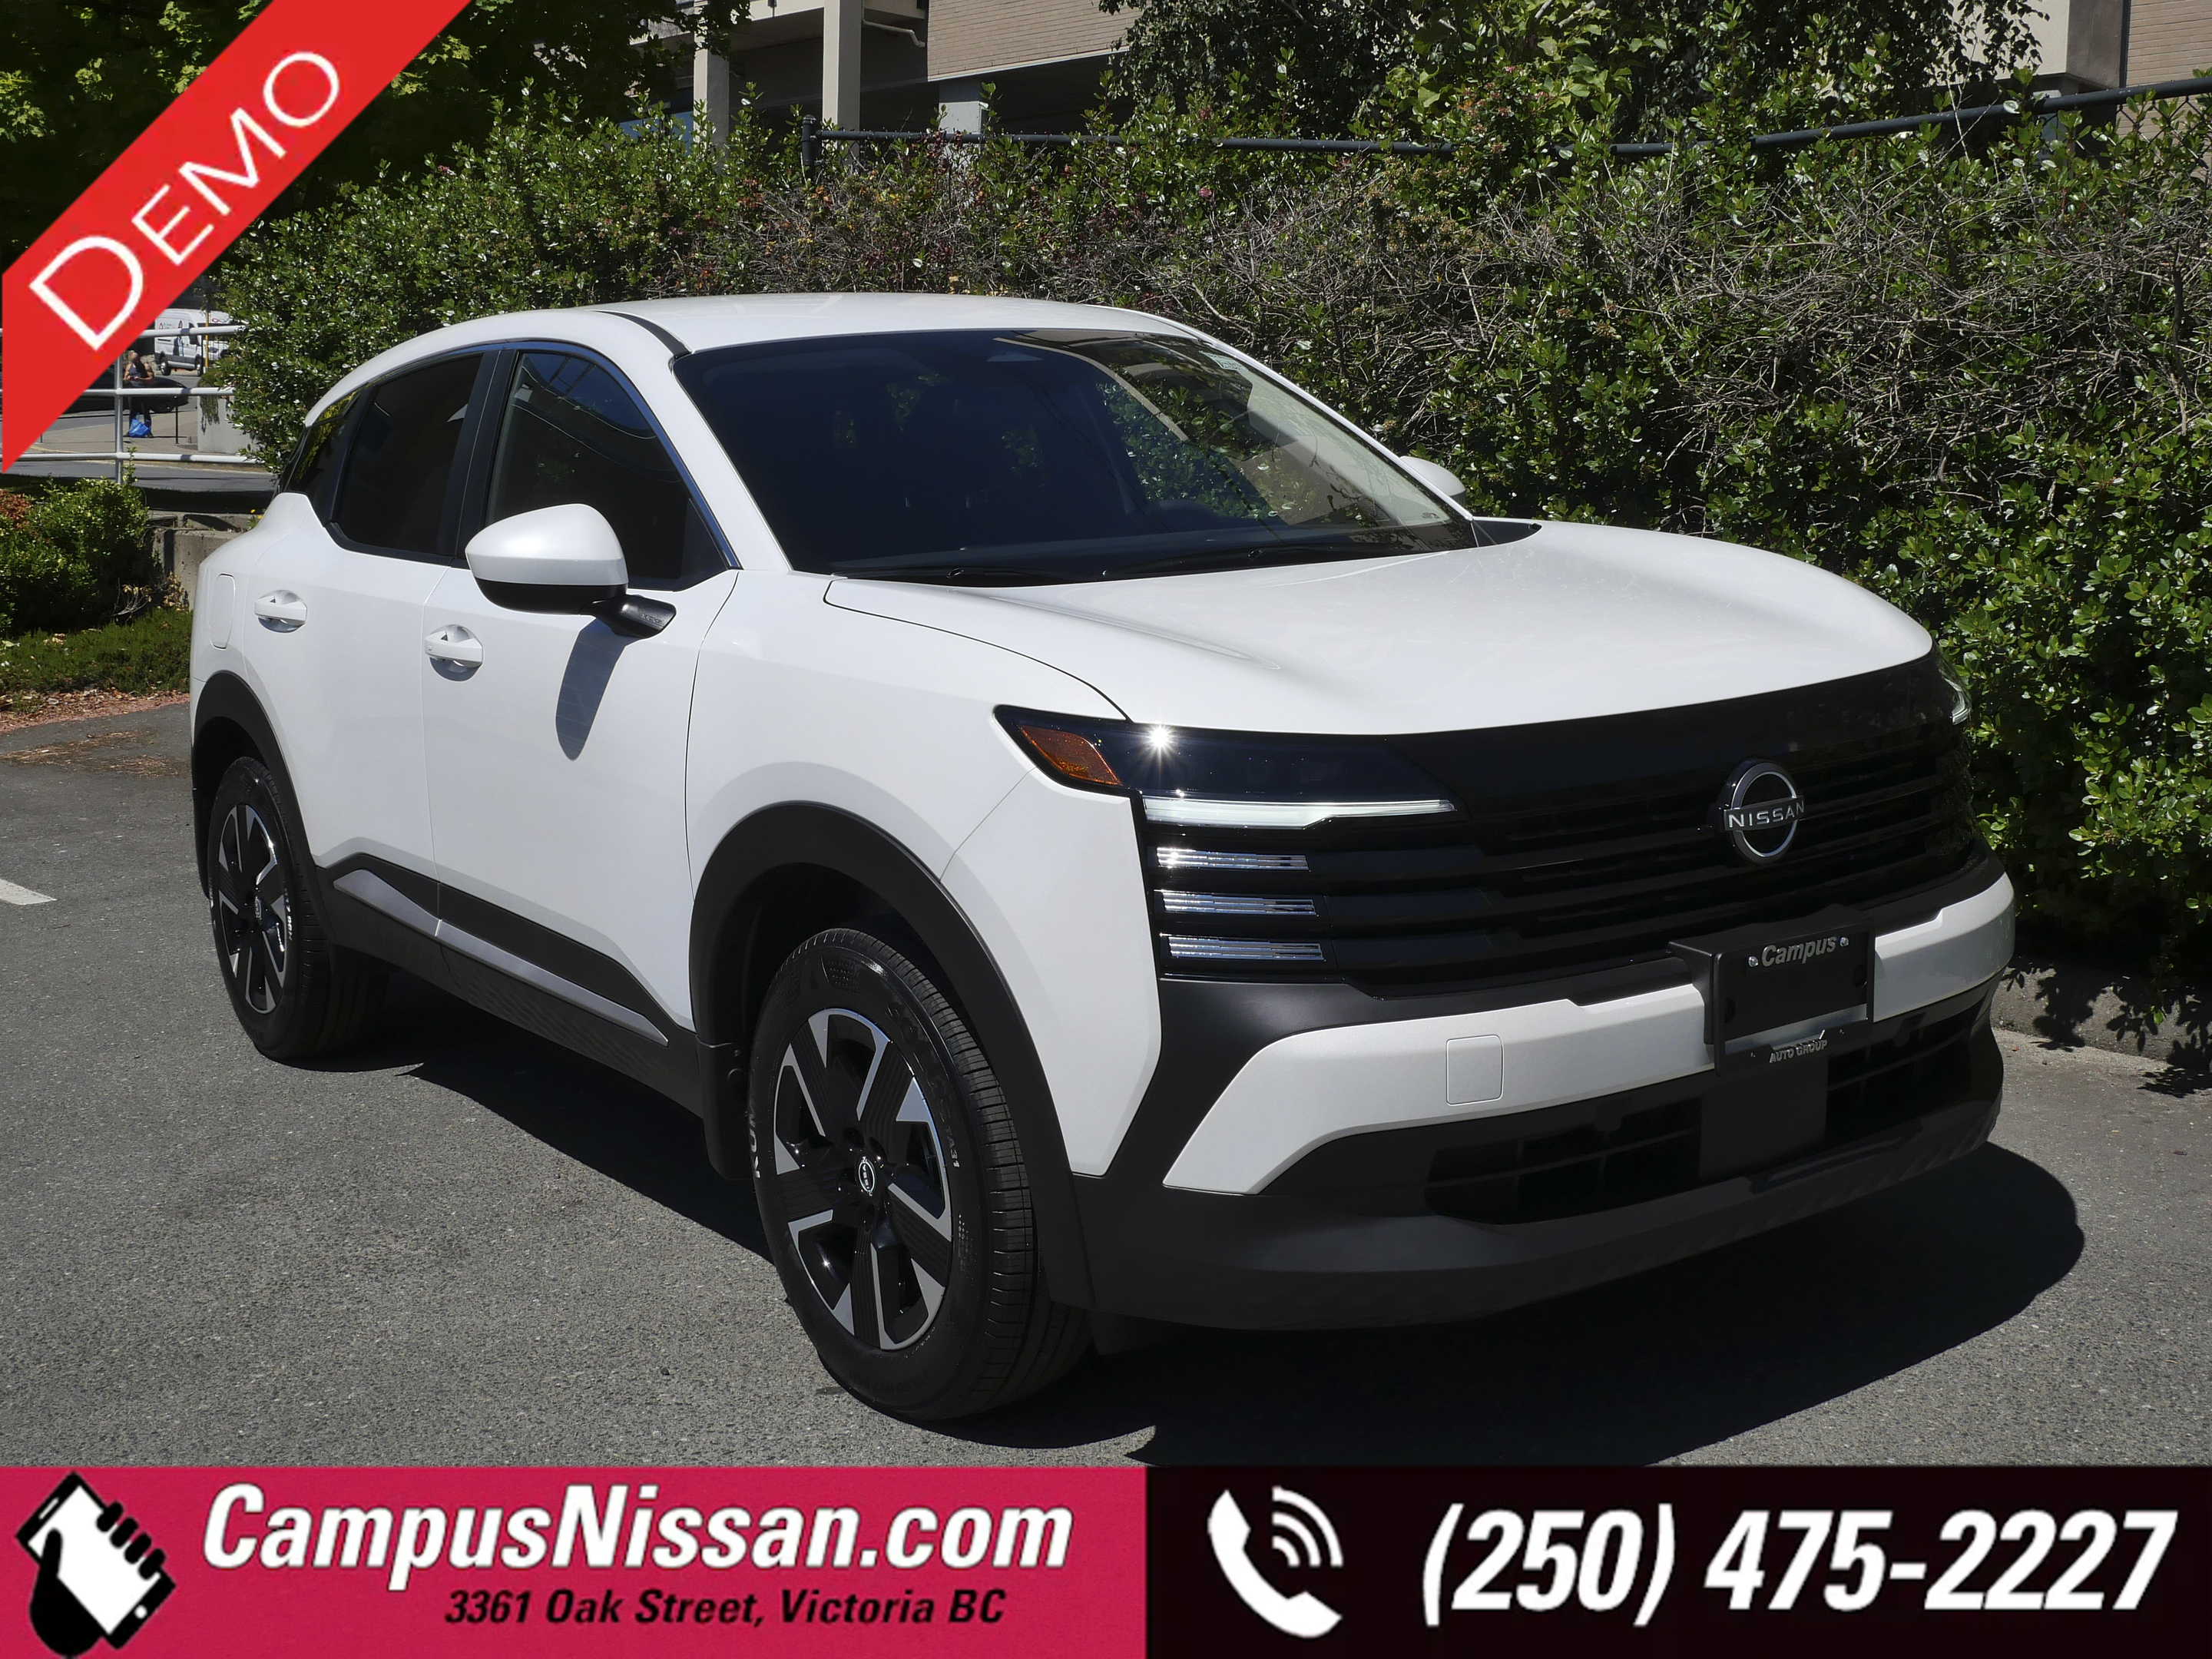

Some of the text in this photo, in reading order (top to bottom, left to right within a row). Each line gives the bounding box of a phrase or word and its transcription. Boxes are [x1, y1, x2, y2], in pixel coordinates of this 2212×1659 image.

[1728, 800, 1805, 828] NISSAN
[1762, 936, 1837, 967] Campus
[1769, 1039, 1828, 1064] AUTO GROUP
[945, 1126, 961, 1169] TA31
